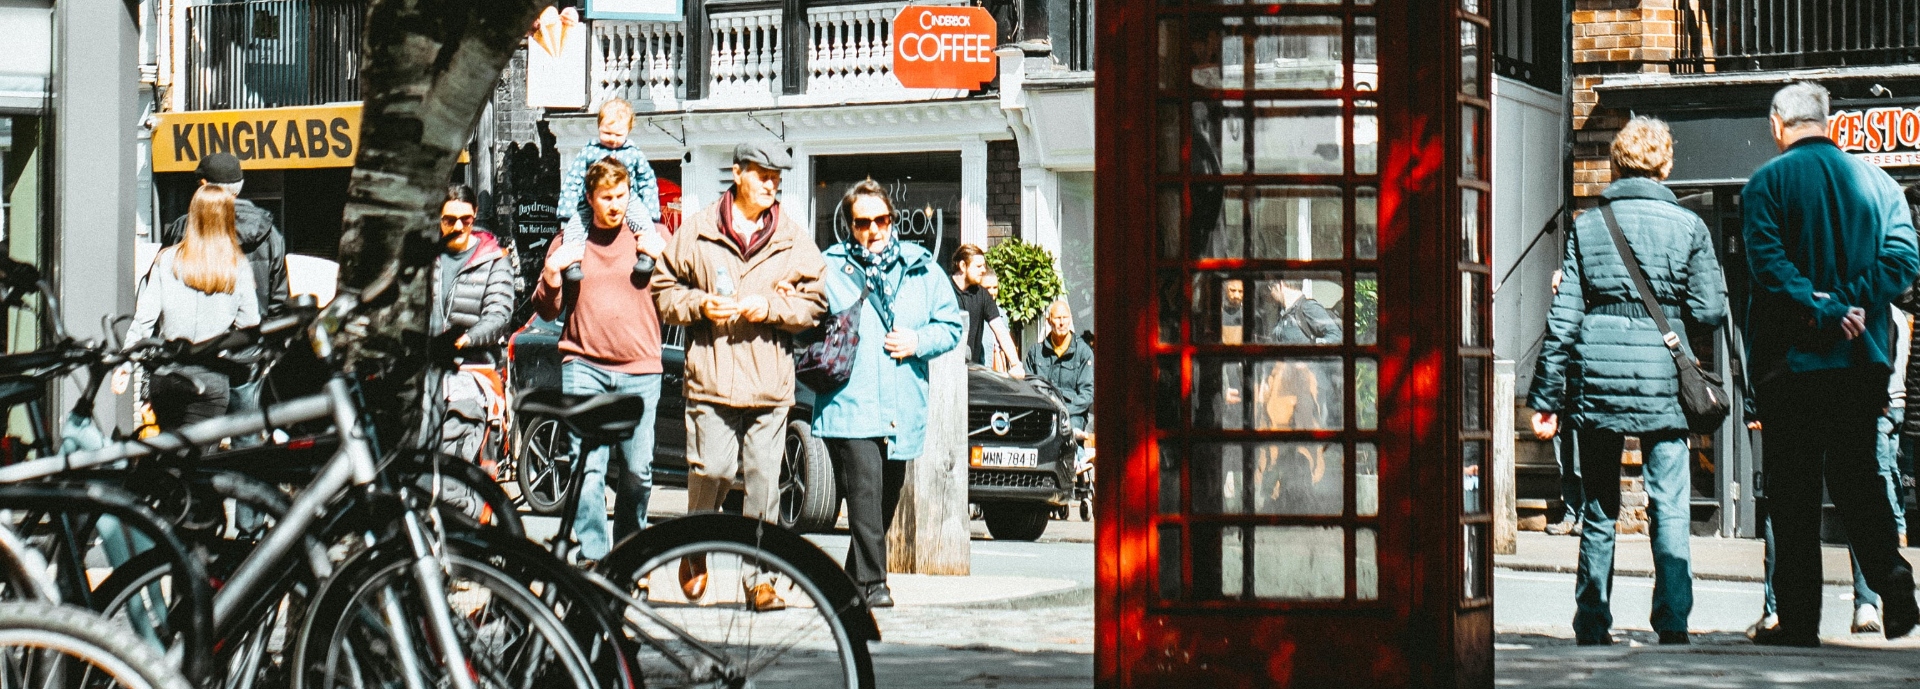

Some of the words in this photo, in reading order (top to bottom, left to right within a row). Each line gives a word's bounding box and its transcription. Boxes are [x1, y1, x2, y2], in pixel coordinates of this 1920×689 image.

[919, 10, 970, 30] CINDERBOX
[899, 32, 990, 62] COFFEE
[173, 117, 353, 162] KINGKABS
[1863, 154, 1920, 164] SSERTS
[519, 201, 556, 216] Daydream
[519, 224, 528, 234] The
[529, 224, 540, 234] Hair
[540, 224, 557, 235] Lounge
[893, 208, 934, 235] RBOX
